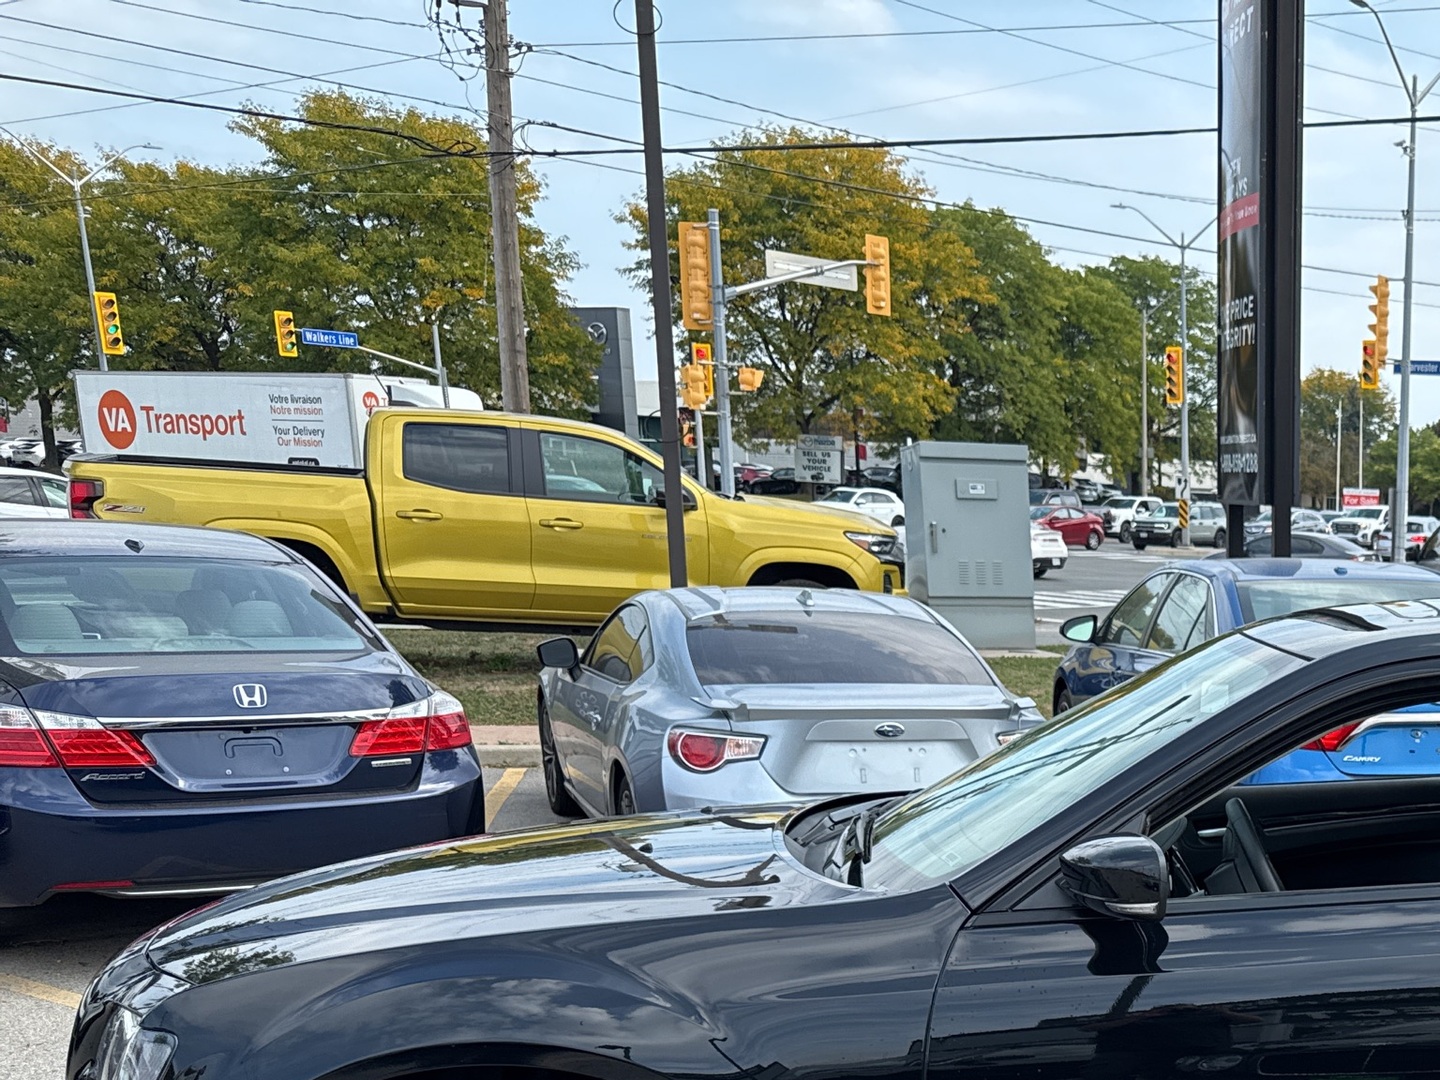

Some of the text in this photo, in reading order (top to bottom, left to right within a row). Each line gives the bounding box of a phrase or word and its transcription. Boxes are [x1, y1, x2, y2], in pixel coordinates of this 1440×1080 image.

[1230, 295, 1254, 321] PRICE
[305, 331, 355, 346] Walkers Line
[1409, 363, 1438, 373] arvester
[268, 393, 322, 405] Votre livraison
[364, 397, 378, 406] VA
[270, 405, 323, 416] Notre mission
[102, 405, 247, 441] VA Transport
[272, 425, 325, 438] Your Delivery
[277, 436, 323, 447] Our Mission
[1344, 496, 1379, 506] For Sale
[1343, 755, 1381, 763] CAMRY
[80, 771, 146, 782] Accord
